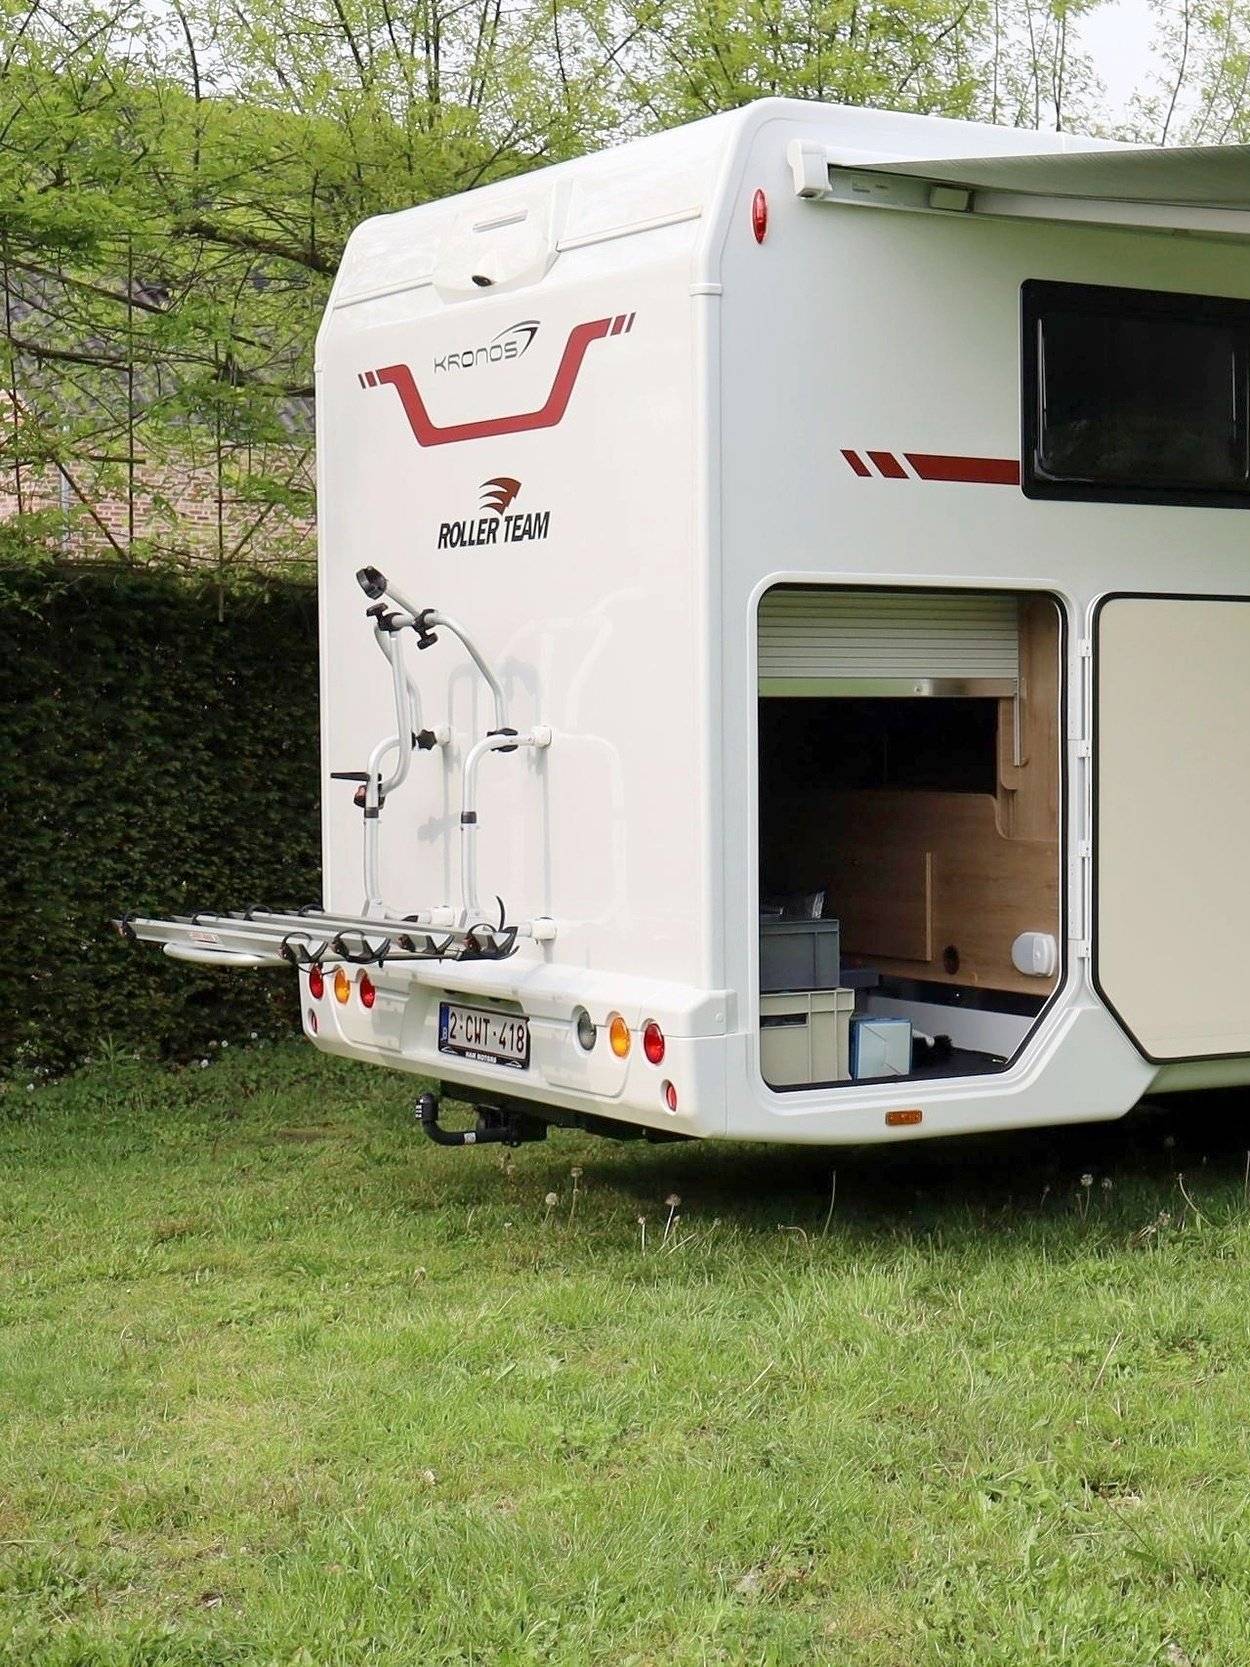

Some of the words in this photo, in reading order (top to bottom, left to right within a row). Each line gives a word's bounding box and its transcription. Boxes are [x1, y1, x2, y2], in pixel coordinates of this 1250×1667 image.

[433, 340, 518, 374] KRONOS
[438, 517, 500, 549] ROLLER
[503, 511, 551, 543] TEAM
